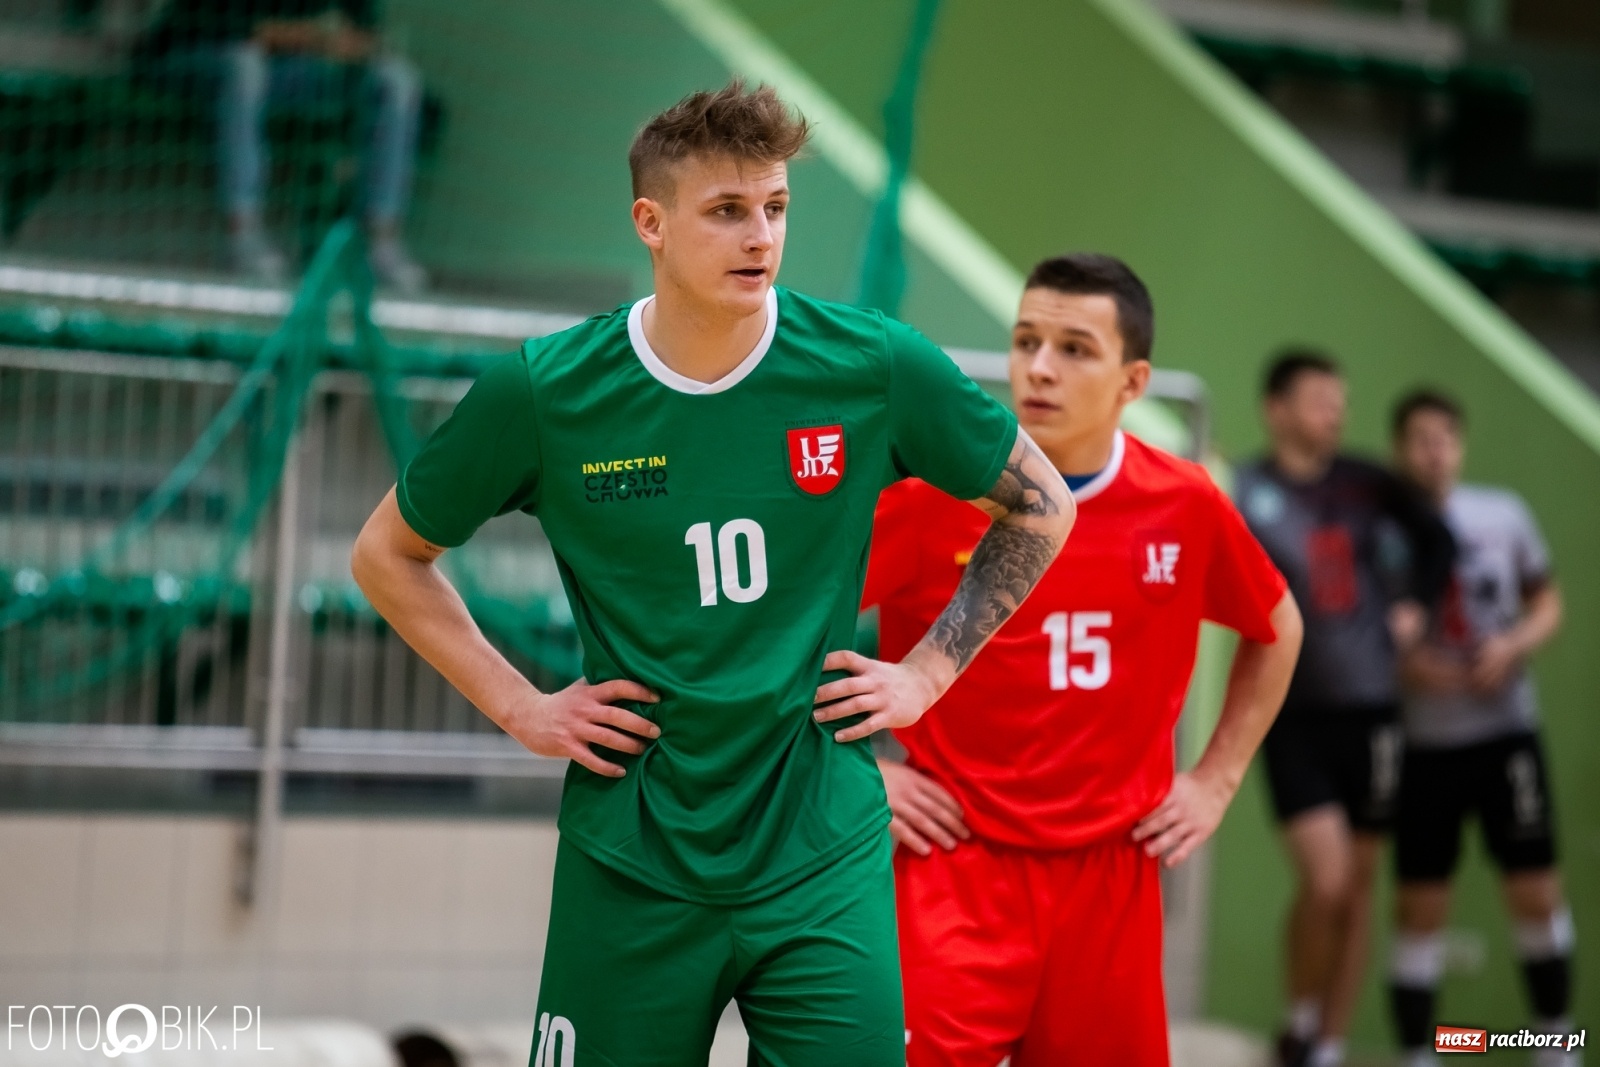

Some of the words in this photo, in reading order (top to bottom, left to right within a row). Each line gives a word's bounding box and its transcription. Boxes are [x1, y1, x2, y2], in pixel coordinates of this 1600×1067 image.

[582, 457, 646, 474] INVEST
[648, 455, 667, 468] IN
[684, 518, 768, 607] 10
[1041, 611, 1112, 690] 15
[534, 1011, 576, 1067] 10
